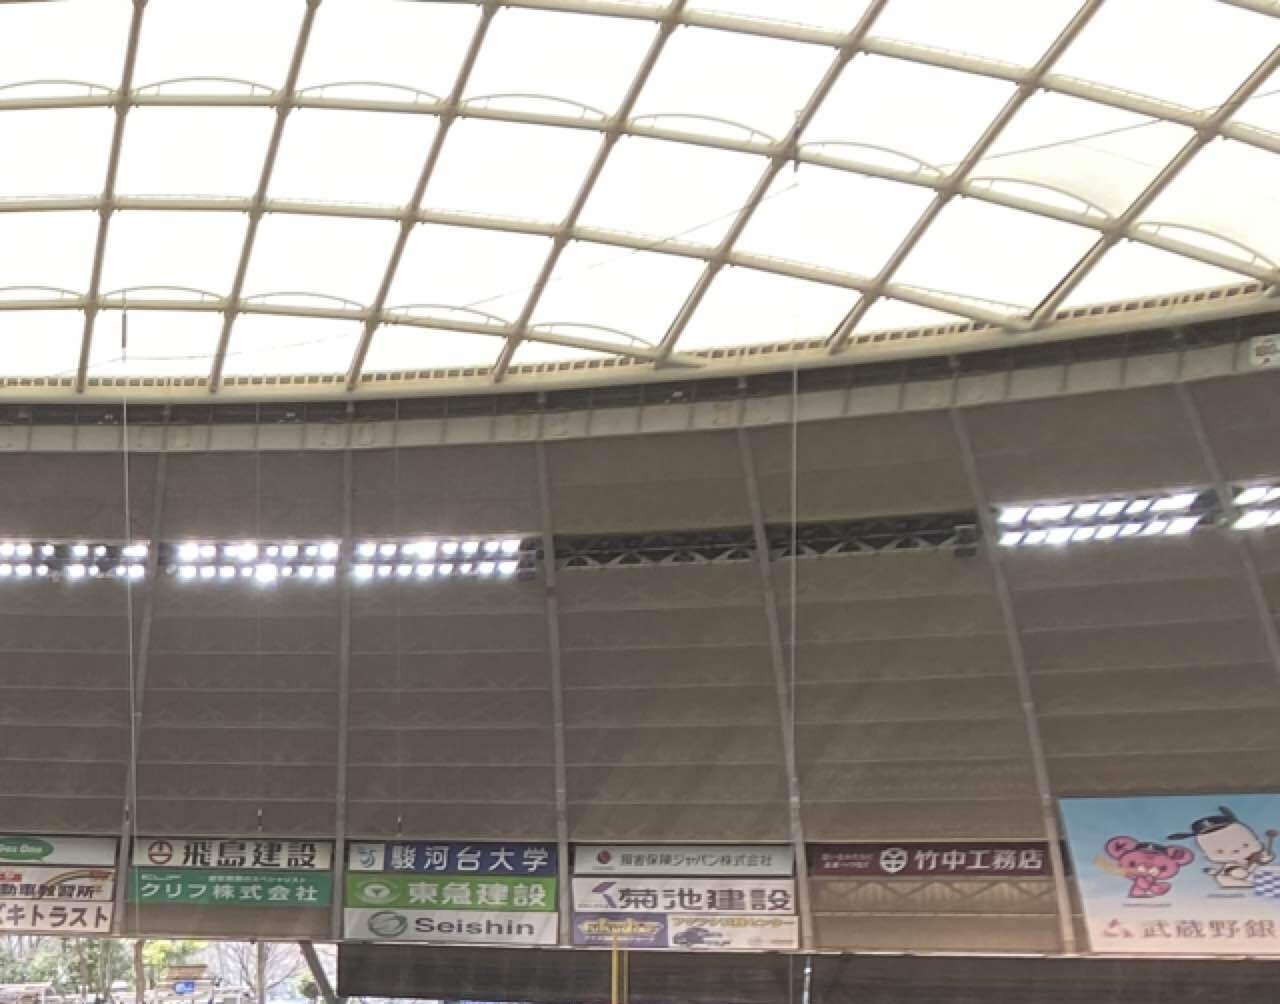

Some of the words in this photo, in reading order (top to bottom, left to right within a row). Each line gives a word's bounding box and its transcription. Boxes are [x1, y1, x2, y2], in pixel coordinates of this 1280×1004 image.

[183, 840, 317, 869] 飛島建設
[391, 844, 550, 873] 駿河台大学
[913, 848, 1045, 871] 竹中工務店
[408, 881, 547, 908] 東急建設
[618, 887, 793, 912] 菊池建設
[415, 917, 536, 937] Seishin
